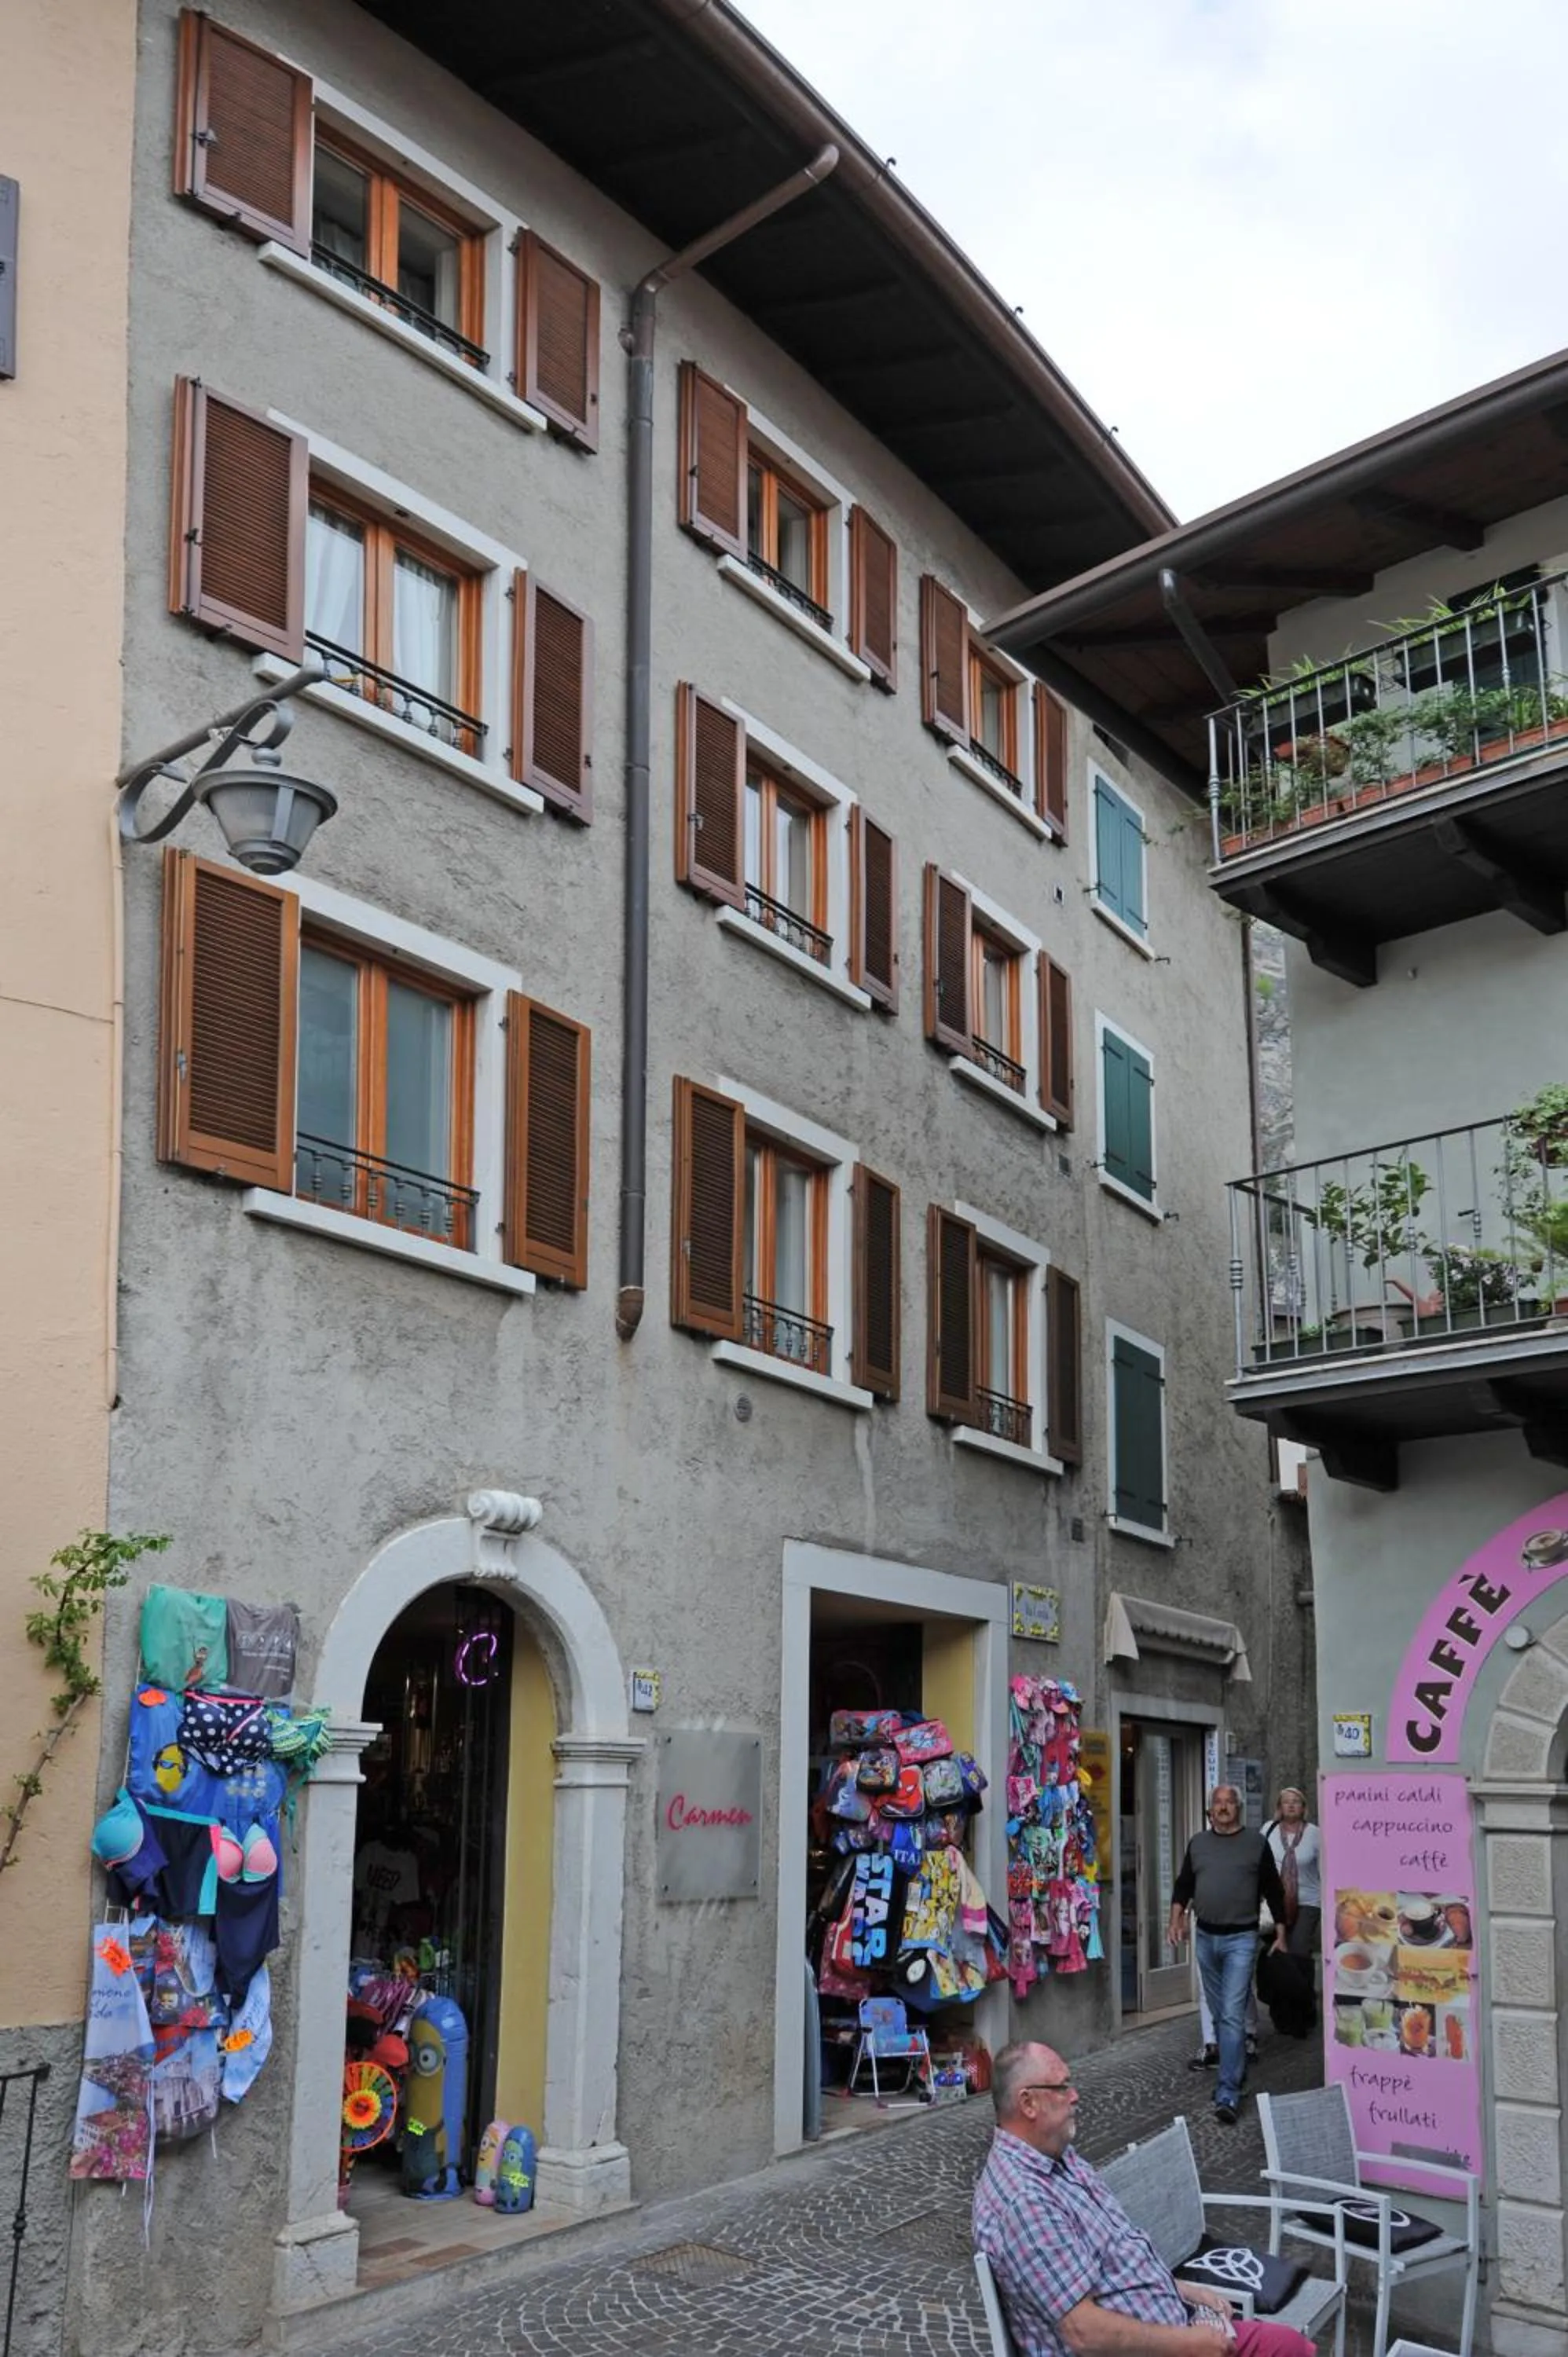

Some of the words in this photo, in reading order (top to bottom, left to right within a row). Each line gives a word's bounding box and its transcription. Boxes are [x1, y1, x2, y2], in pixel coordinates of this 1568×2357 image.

[1406, 1573, 1512, 1754] CAFFÈ
[1335, 1787, 1389, 1806] panini
[1397, 1787, 1442, 1803] caldi
[1352, 1818, 1453, 1836] cappuccino
[1399, 1849, 1449, 1872] caffè
[863, 1853, 895, 1966] STAR
[1350, 2065, 1415, 2095] frappè
[1368, 2101, 1438, 2129] frullati
